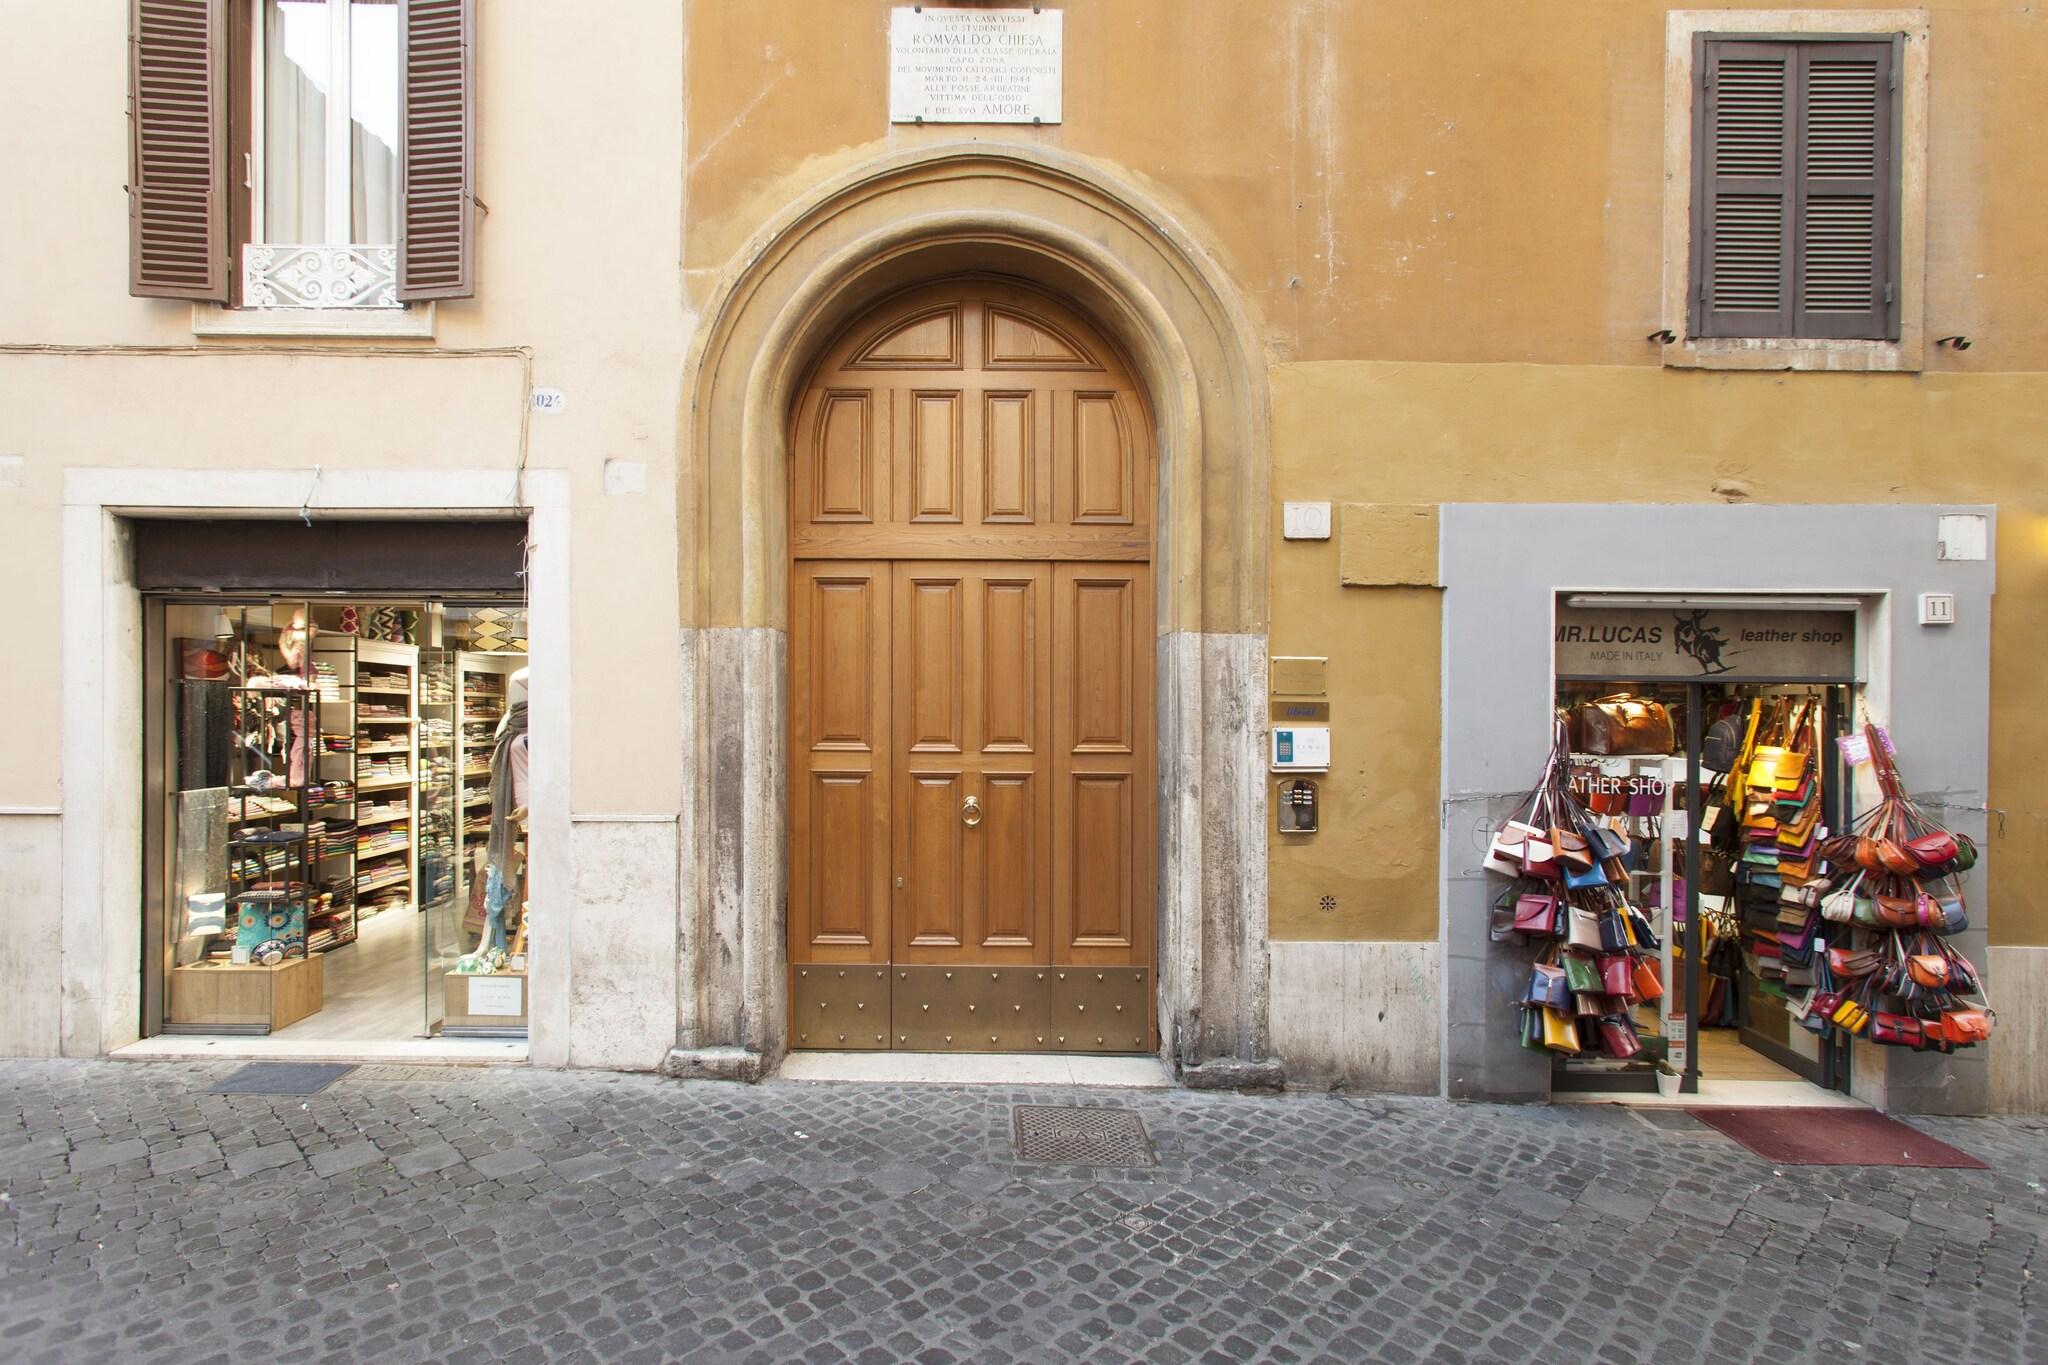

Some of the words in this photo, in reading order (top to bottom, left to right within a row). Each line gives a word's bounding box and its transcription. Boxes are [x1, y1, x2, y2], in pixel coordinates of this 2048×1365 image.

[925, 15, 934, 23] IN
[936, 15, 971, 23] QVESTA
[974, 15, 997, 23] CASA
[945, 24, 958, 32] LO
[961, 24, 1008, 33] STVDENTE
[913, 33, 991, 46] ROMVALDO
[998, 34, 1043, 46] CHIESA
[896, 47, 950, 55] VOLONTARIO
[982, 47, 1013, 56] CLASSE
[915, 65, 963, 73] MOVIMENTO
[924, 75, 958, 83] MORTO
[924, 84, 946, 92] ALLE
[951, 84, 978, 92] FOSSE
[983, 84, 1032, 93] ARDEATINE
[929, 94, 967, 102] VITTIMA
[982, 103, 1031, 115] AMORE
[1930, 601, 1947, 616] 11
[1740, 627, 1798, 643] leather
[1801, 628, 1843, 646] shop
[1590, 651, 1620, 661] MADE
[1622, 651, 1633, 661] IN
[1635, 651, 1663, 662] ITALY
[1568, 776, 1621, 795] ATHER
